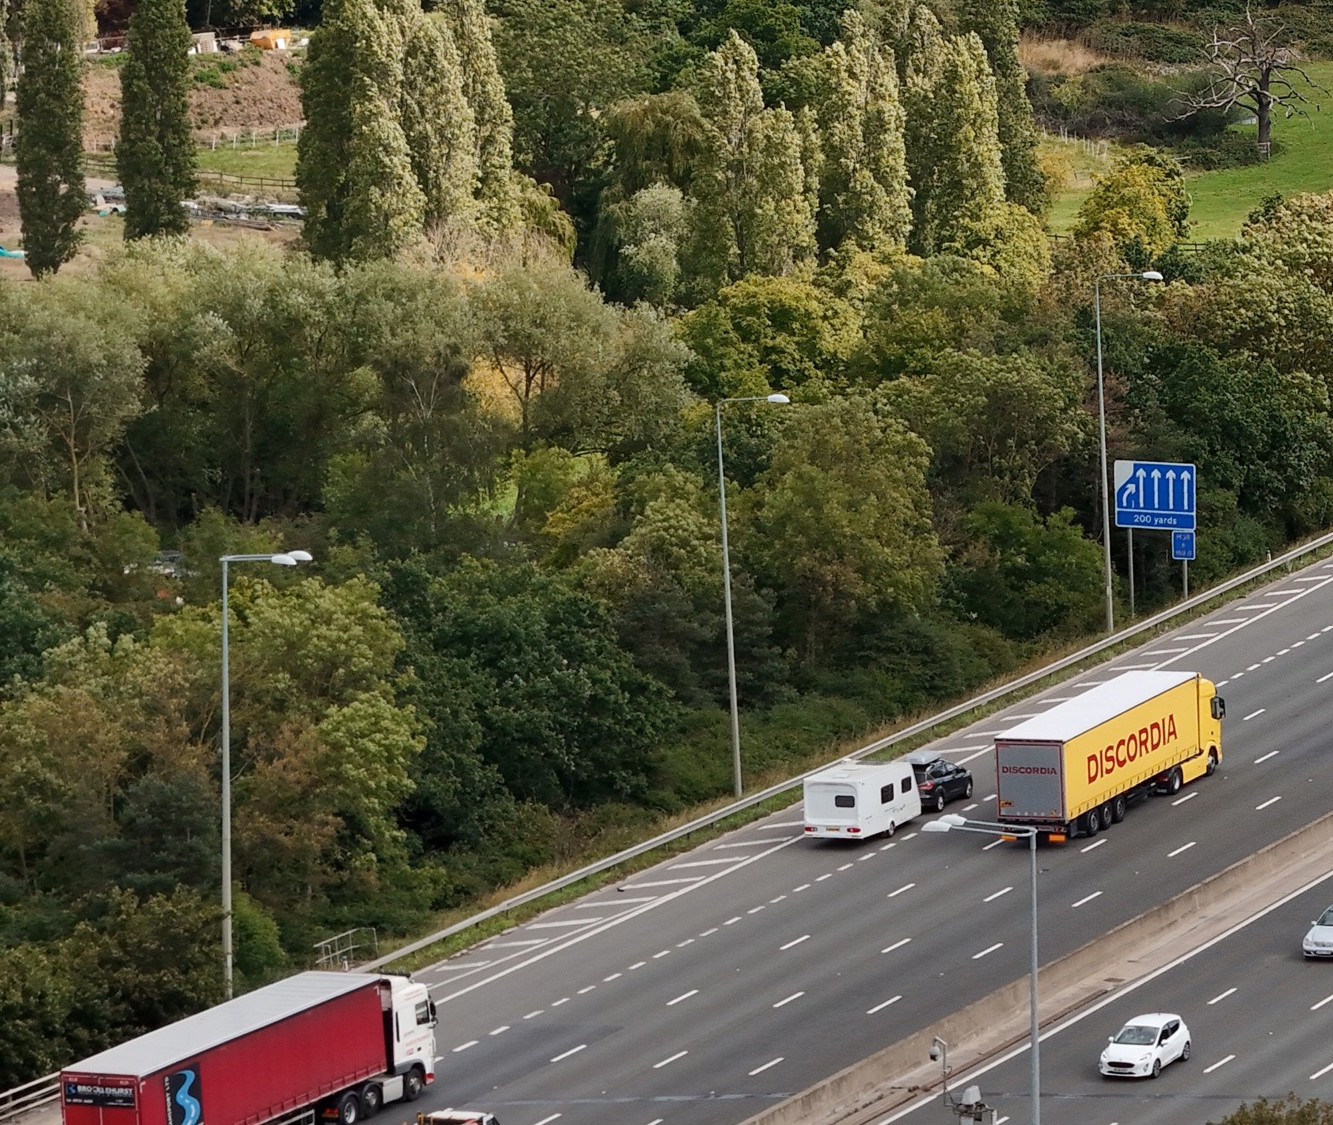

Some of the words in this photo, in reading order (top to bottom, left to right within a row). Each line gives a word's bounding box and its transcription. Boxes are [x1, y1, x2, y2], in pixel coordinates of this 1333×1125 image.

[1133, 514, 1152, 524] 200
[1153, 516, 1178, 526] yards
[1087, 713, 1178, 785] DISCORDIA
[1001, 766, 1057, 775] DISCORDIA
